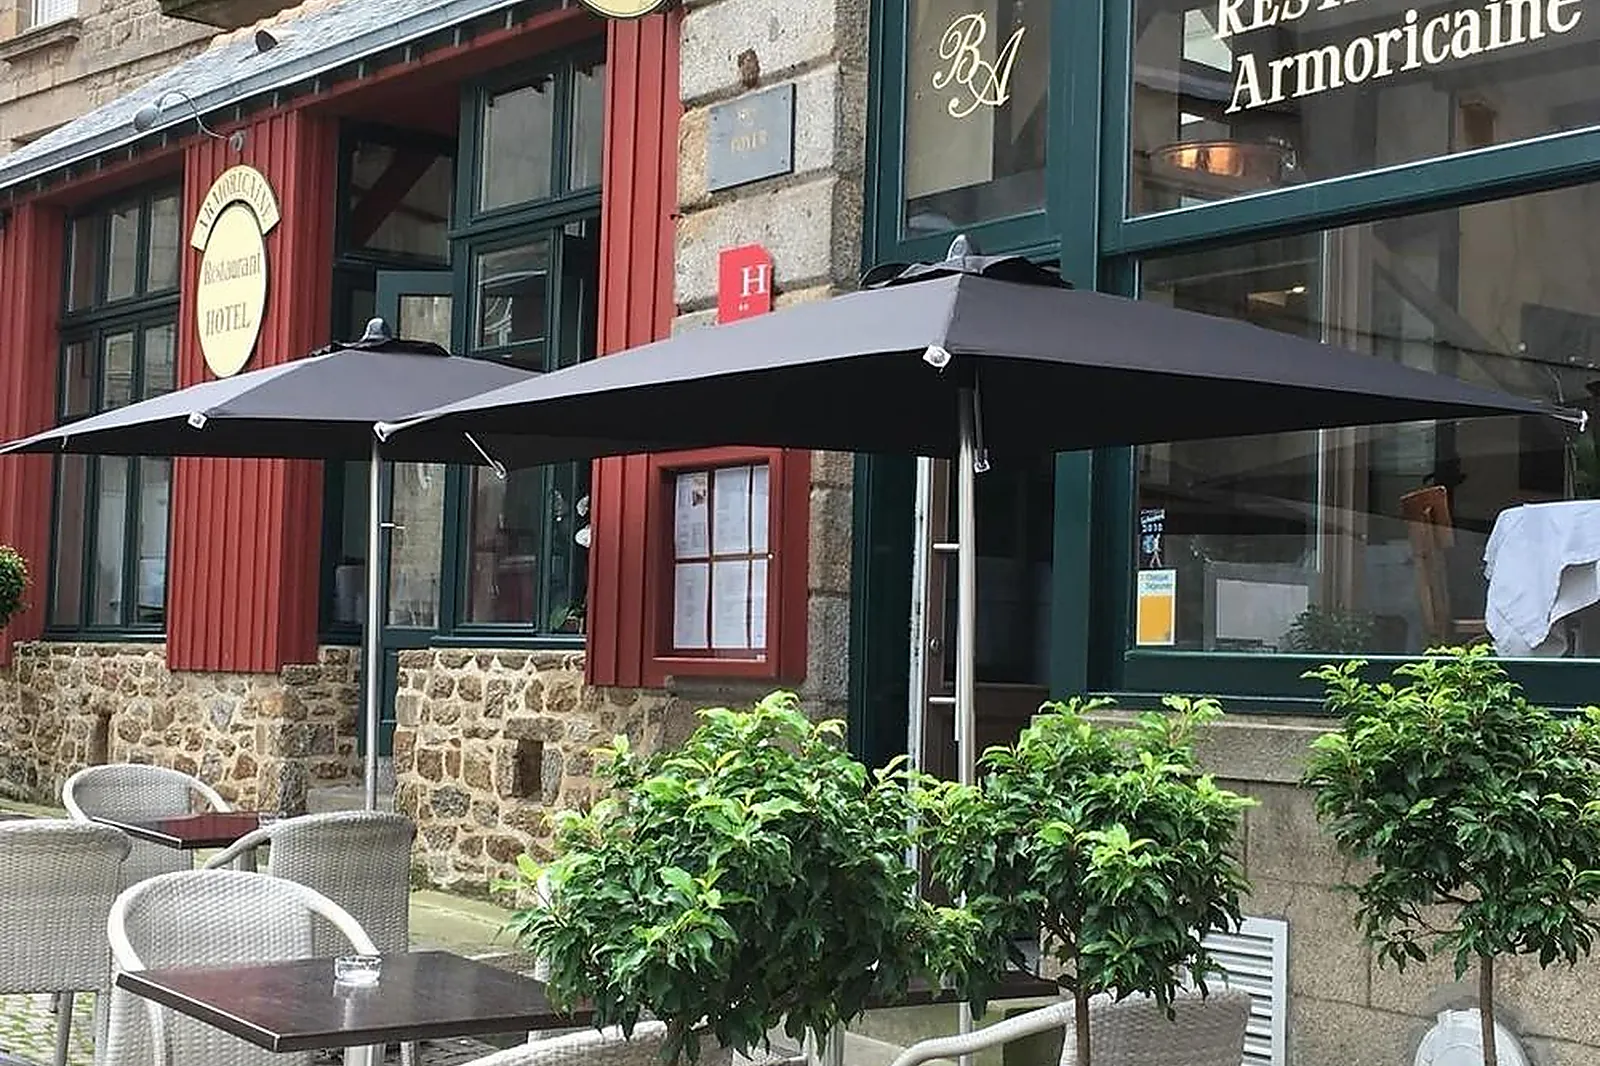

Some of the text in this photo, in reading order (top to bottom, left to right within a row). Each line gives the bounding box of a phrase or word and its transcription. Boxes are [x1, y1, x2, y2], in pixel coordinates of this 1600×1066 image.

[1224, 0, 1582, 114] Armoricaine
[204, 252, 261, 286] Restaurant
[740, 264, 769, 297] H
[206, 302, 251, 337] HOTEL
